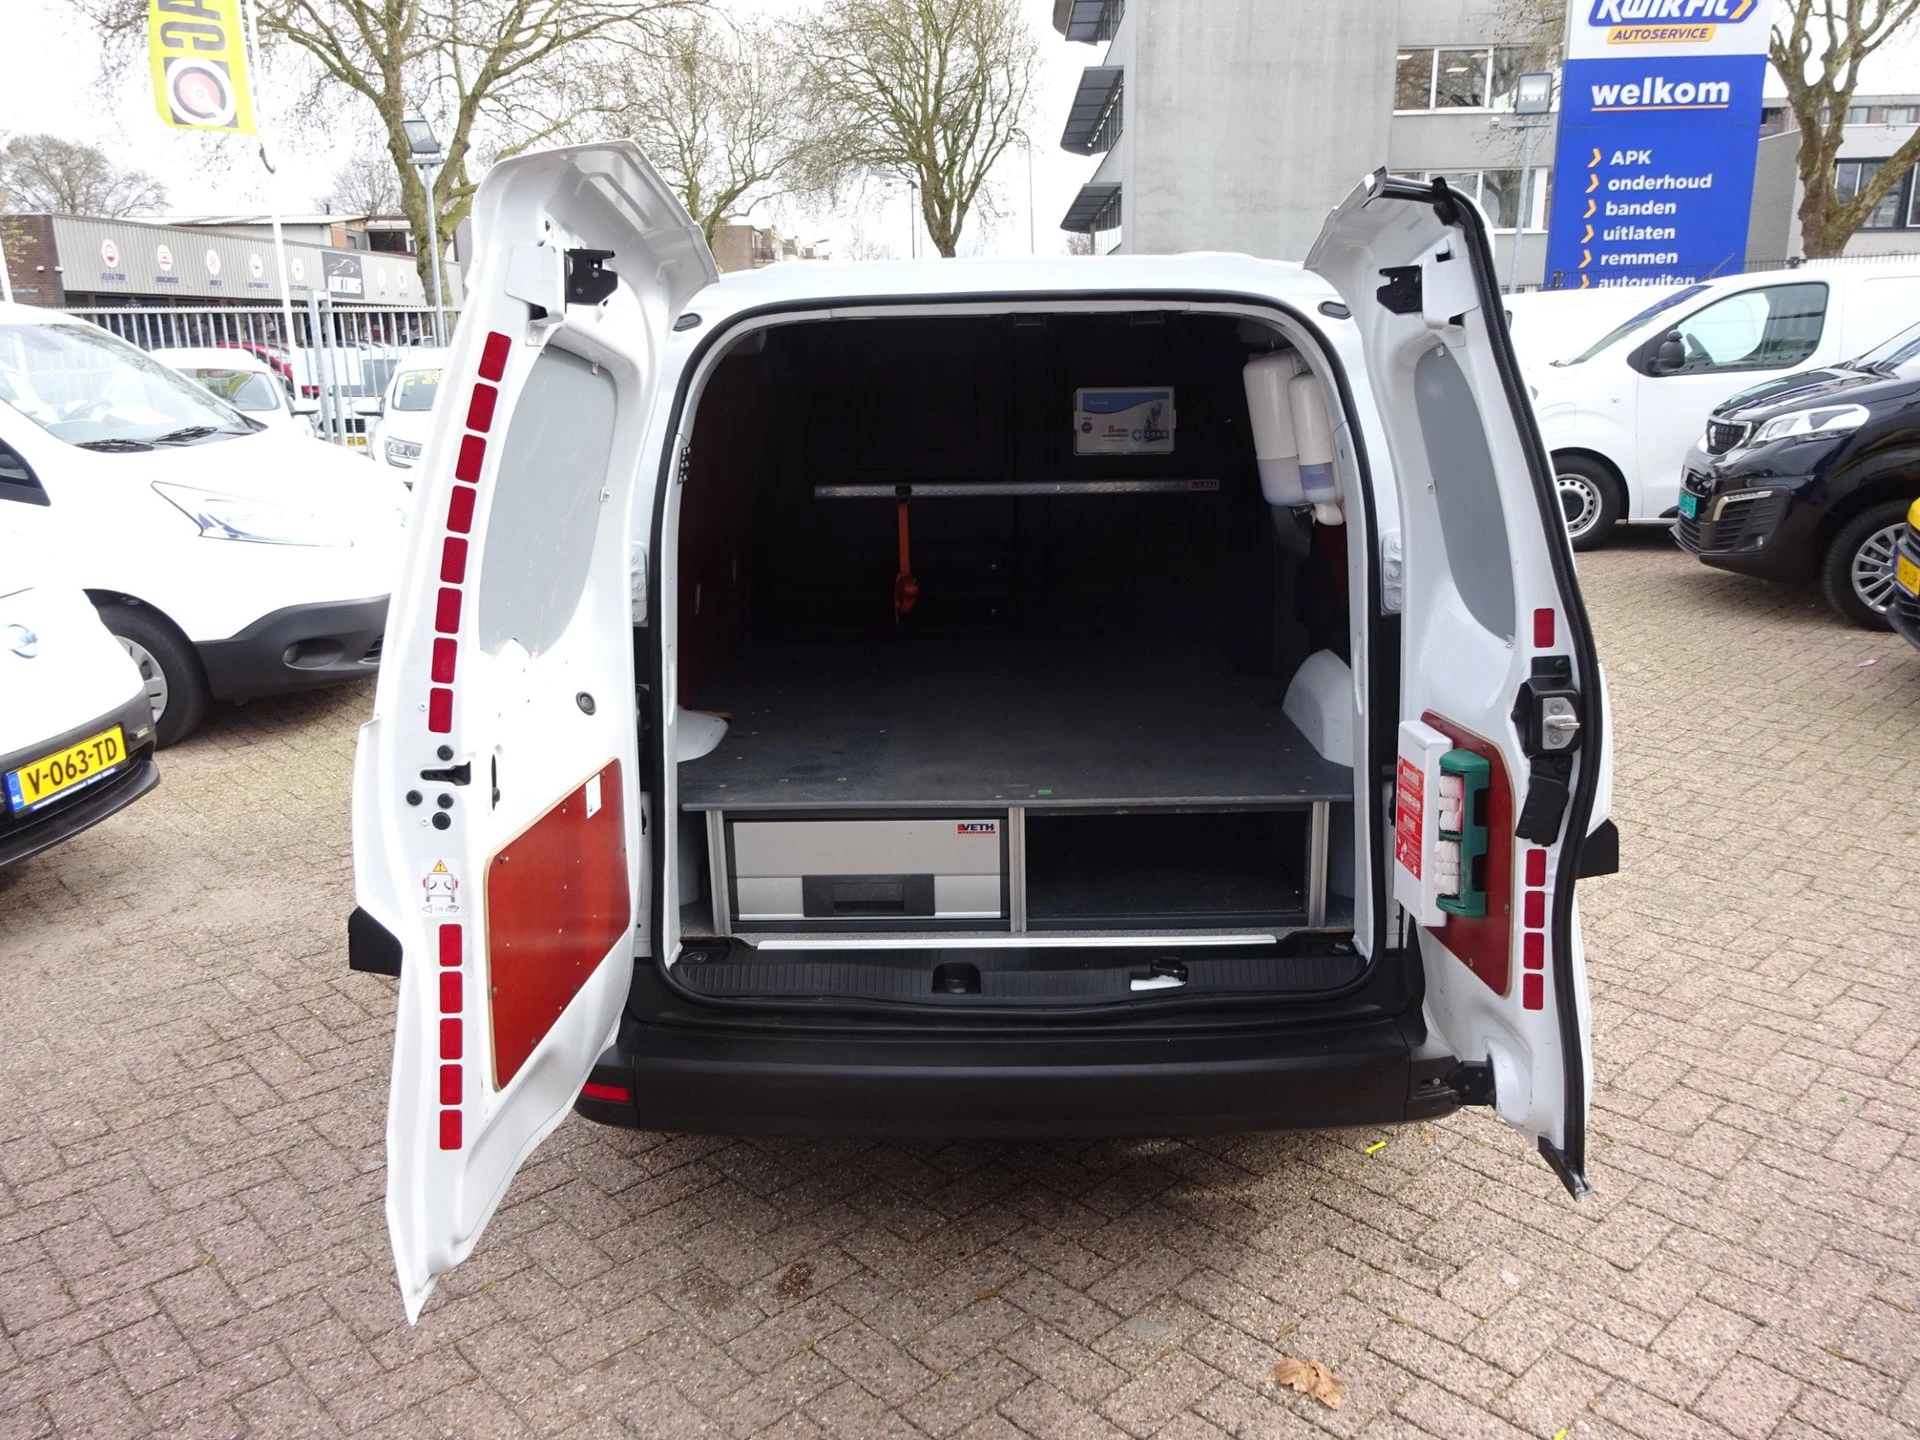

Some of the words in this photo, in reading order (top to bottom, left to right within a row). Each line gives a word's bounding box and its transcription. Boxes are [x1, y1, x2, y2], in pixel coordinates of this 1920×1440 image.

[1613, 28, 1709, 41] AUTOSERVICE
[1591, 77, 1730, 106] welkom
[1609, 149, 1652, 165] APK
[1607, 173, 1713, 191] onderhoud
[1605, 200, 1677, 216] banden
[1603, 226, 1676, 241] uitlaten
[1600, 252, 1678, 266] remmen
[1599, 273, 1696, 288] autoruiten
[27, 737, 118, 795] V-063-TD
[959, 823, 994, 831] VETH
